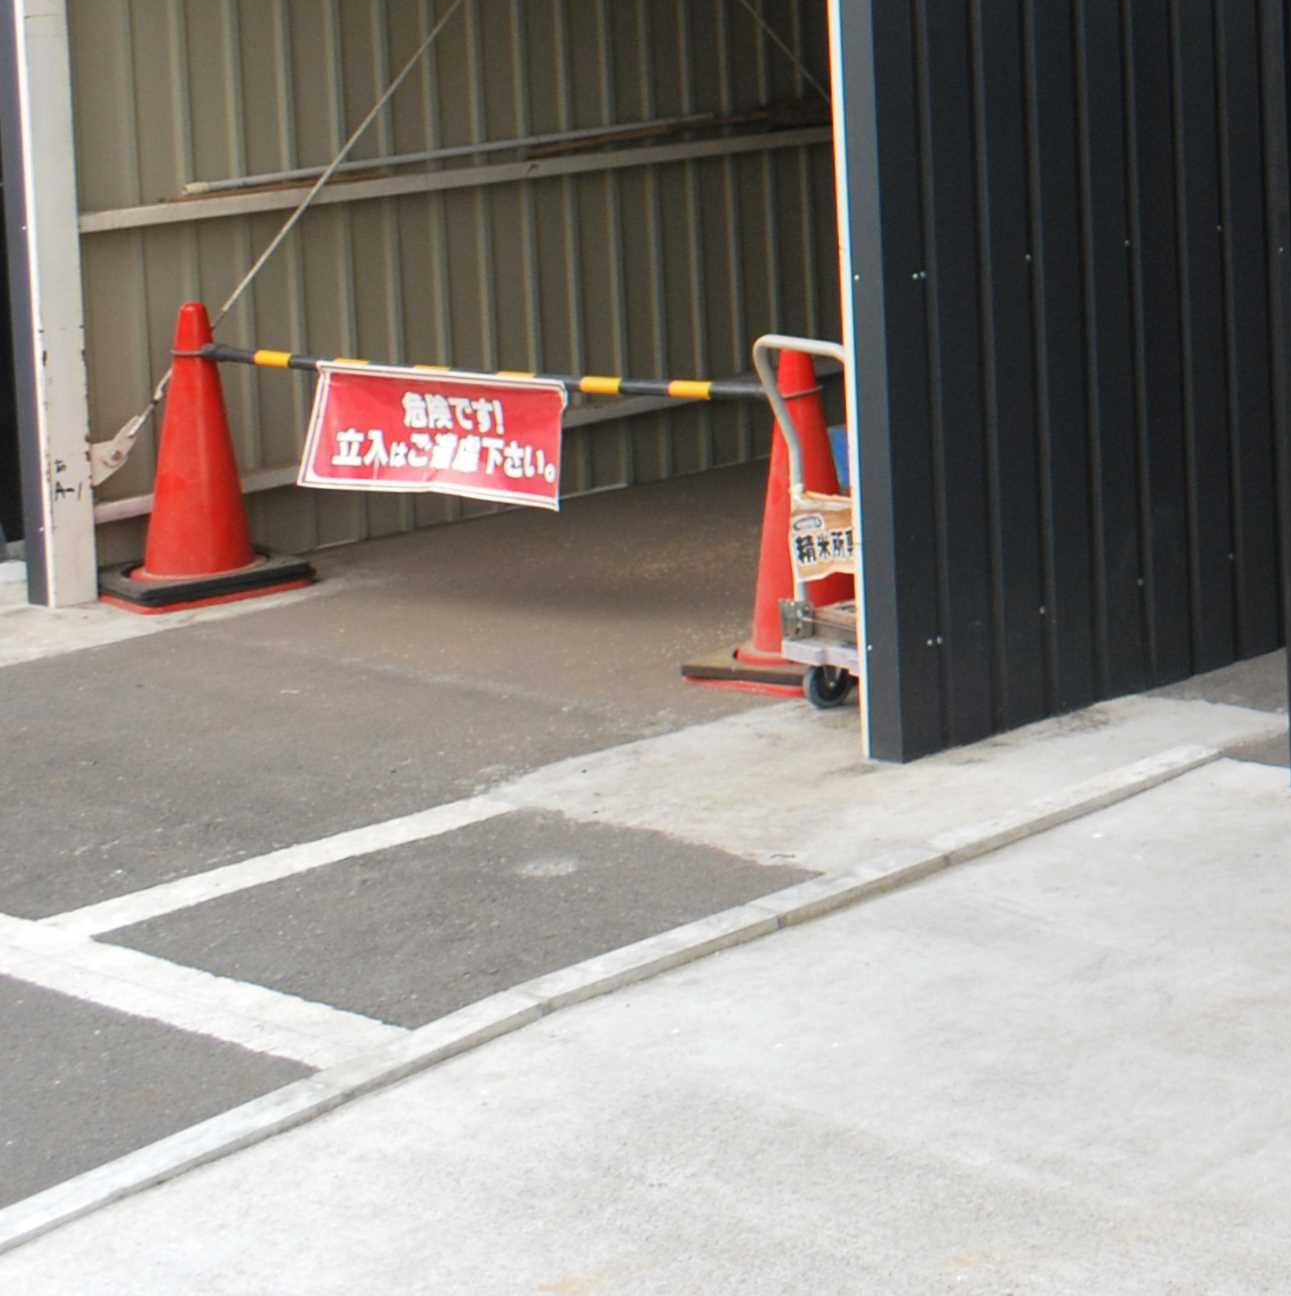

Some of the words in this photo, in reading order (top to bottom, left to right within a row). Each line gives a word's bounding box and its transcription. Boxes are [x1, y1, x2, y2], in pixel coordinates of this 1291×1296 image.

[403, 391, 505, 436] 危険です!
[334, 426, 557, 484] 立入はご遠慮下さい。
